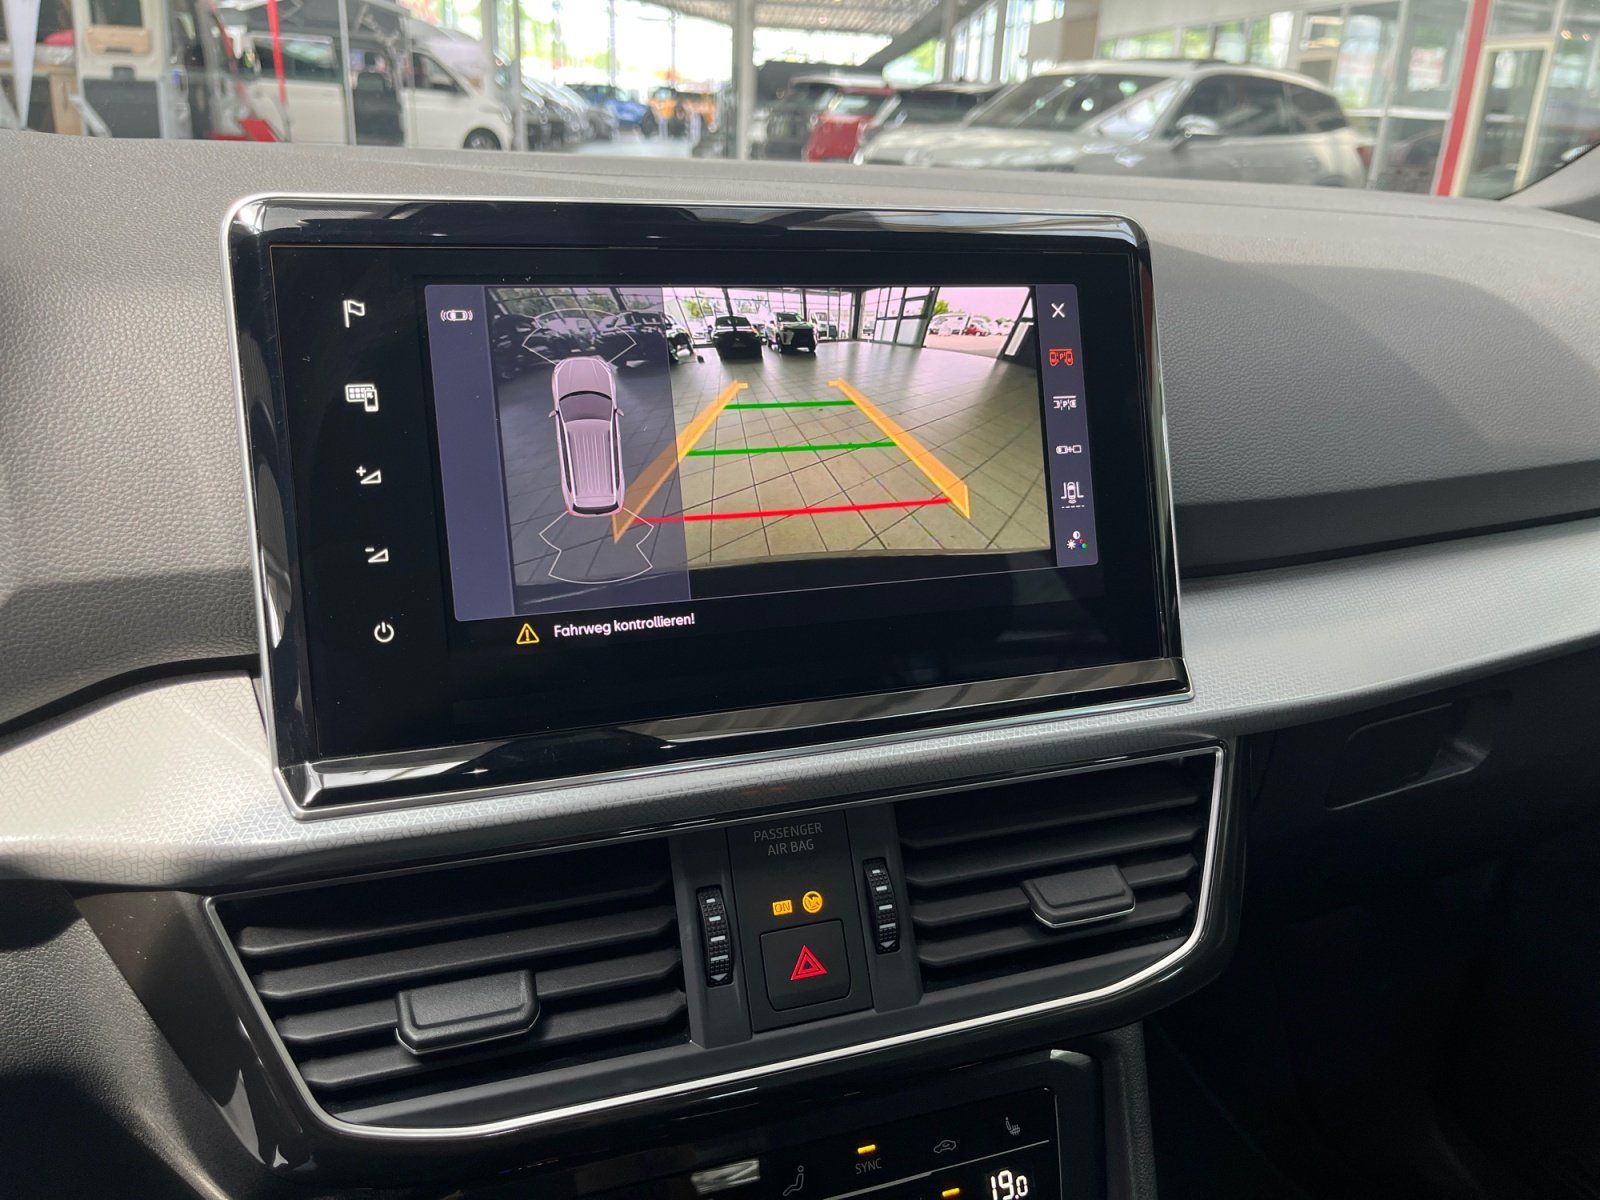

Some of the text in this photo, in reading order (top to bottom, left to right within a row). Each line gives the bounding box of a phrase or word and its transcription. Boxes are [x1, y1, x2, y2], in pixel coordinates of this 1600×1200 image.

[553, 612, 695, 637] Fahrweg kontrollieren!
[753, 822, 823, 842] PASSENGER
[768, 839, 815, 856] AIR BAG
[774, 901, 791, 914] ON
[855, 1157, 882, 1174] SYNC
[990, 1169, 1029, 1200] 19.0
